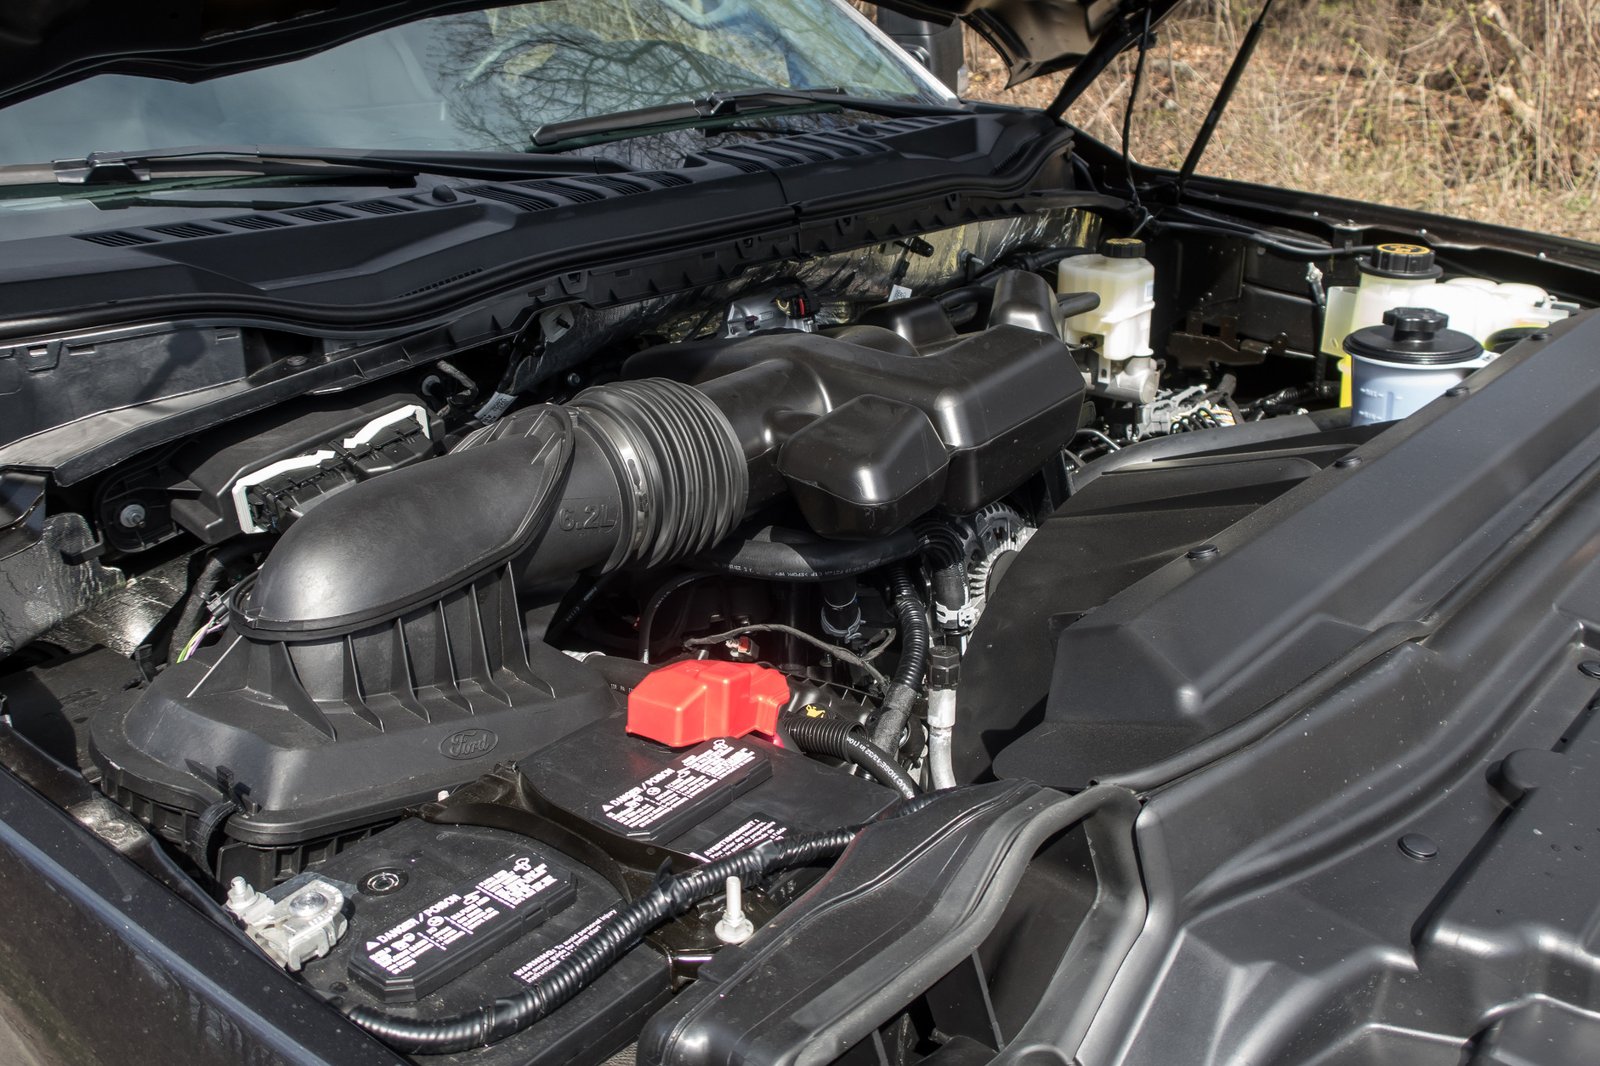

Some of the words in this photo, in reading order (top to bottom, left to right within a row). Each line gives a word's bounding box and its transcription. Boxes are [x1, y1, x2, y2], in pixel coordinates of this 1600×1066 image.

[560, 504, 615, 531] 6.2L
[448, 730, 490, 757] Ford
[609, 786, 644, 806] DANGER
[644, 768, 675, 786] POISON
[376, 917, 420, 944] DANGER
[423, 893, 462, 917] POISON
[513, 949, 557, 976] WARNING:
[562, 933, 579, 946] avoid
[577, 918, 602, 937] personal
[599, 909, 617, 921] injury
[549, 949, 567, 961] guide
[573, 934, 589, 946] jump
[587, 925, 602, 936] start
